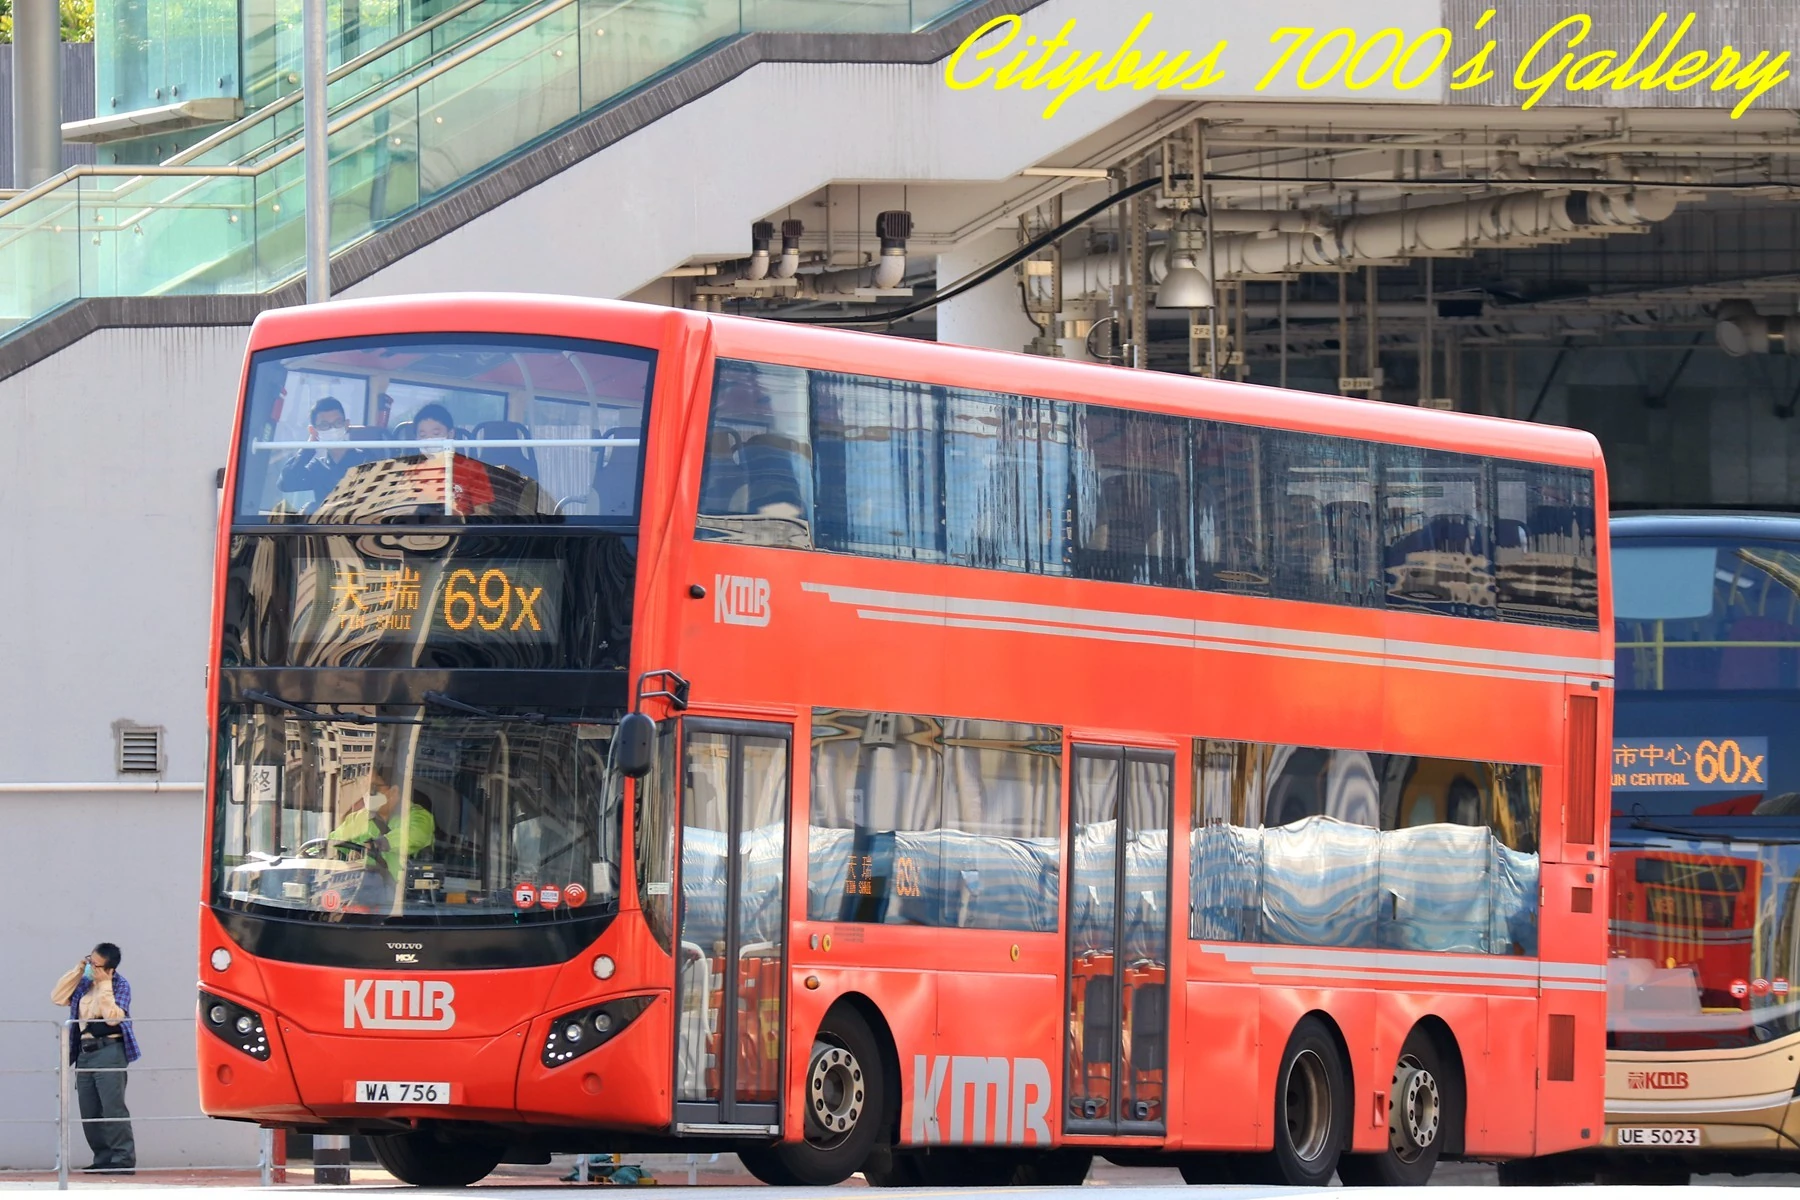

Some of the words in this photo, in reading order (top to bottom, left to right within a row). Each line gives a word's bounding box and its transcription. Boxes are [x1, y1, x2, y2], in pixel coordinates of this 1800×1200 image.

[331, 567, 421, 611] 天瑞
[444, 569, 542, 631] 69x
[338, 615, 364, 630] TIN
[376, 615, 412, 630] SHUI
[1612, 744, 1691, 767] 市中心
[1695, 740, 1765, 784] 60x
[1630, 773, 1690, 786] CENTRAL
[386, 942, 423, 950] VOLVO
[395, 953, 418, 963] MCV
[365, 1083, 389, 1101] WA
[400, 1083, 437, 1102] 756
[1621, 1129, 1644, 1143] UE
[1651, 1129, 1696, 1144] 5023
